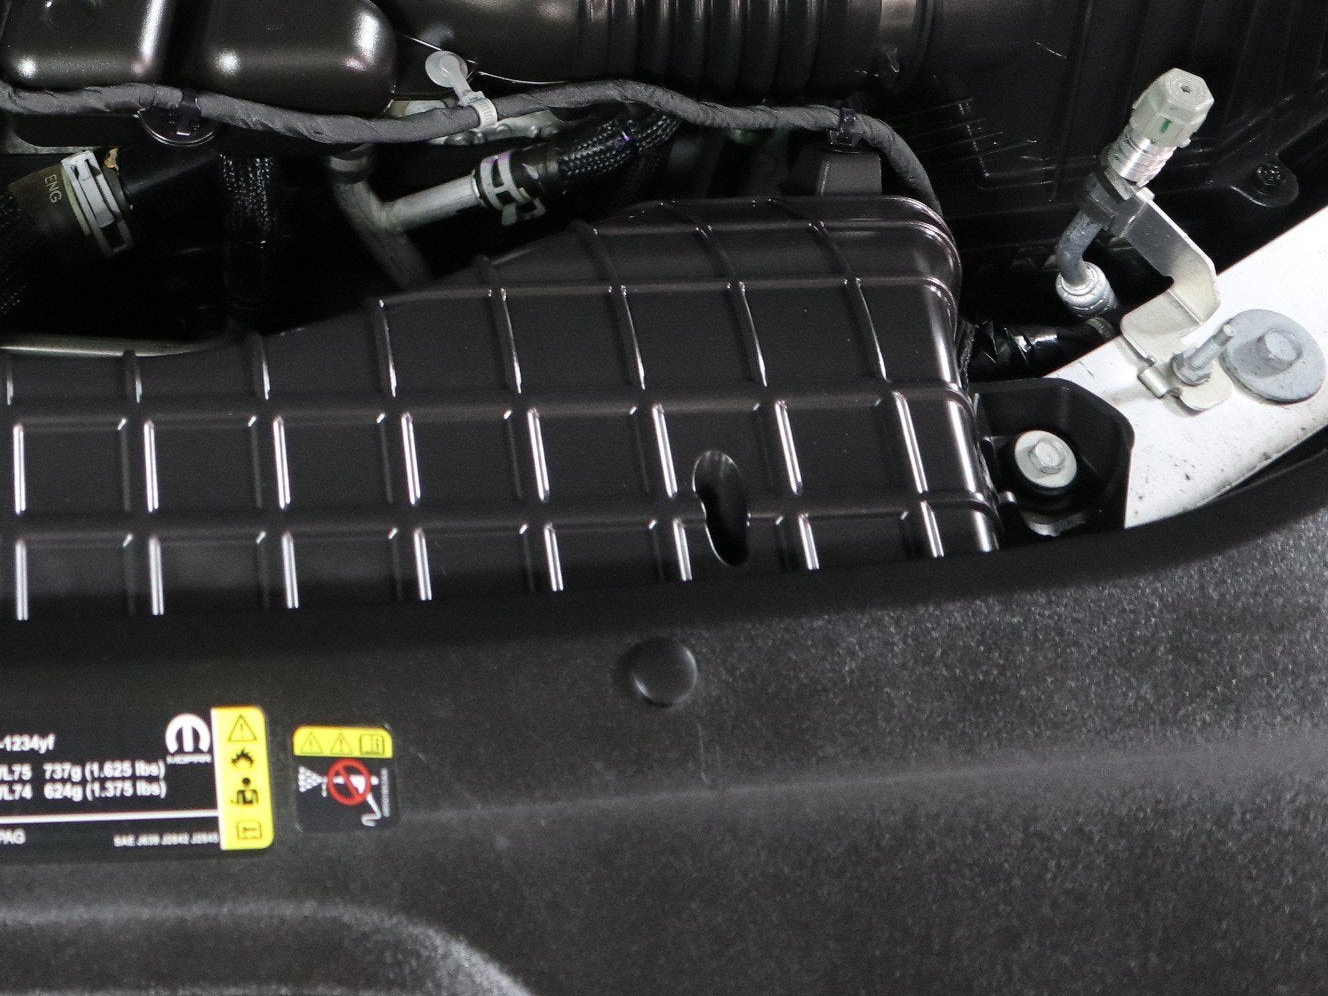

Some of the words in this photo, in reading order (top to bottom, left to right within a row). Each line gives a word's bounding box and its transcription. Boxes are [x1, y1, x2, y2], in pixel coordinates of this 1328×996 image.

[44, 174, 62, 204] ENG
[43, 762, 82, 782] 737g
[84, 760, 133, 782] (1.625
[135, 759, 166, 780] lbs)
[43, 781, 83, 802] 624g
[85, 779, 134, 802] (1.375
[136, 779, 167, 799] lbs)
[113, 833, 136, 847] SAE
